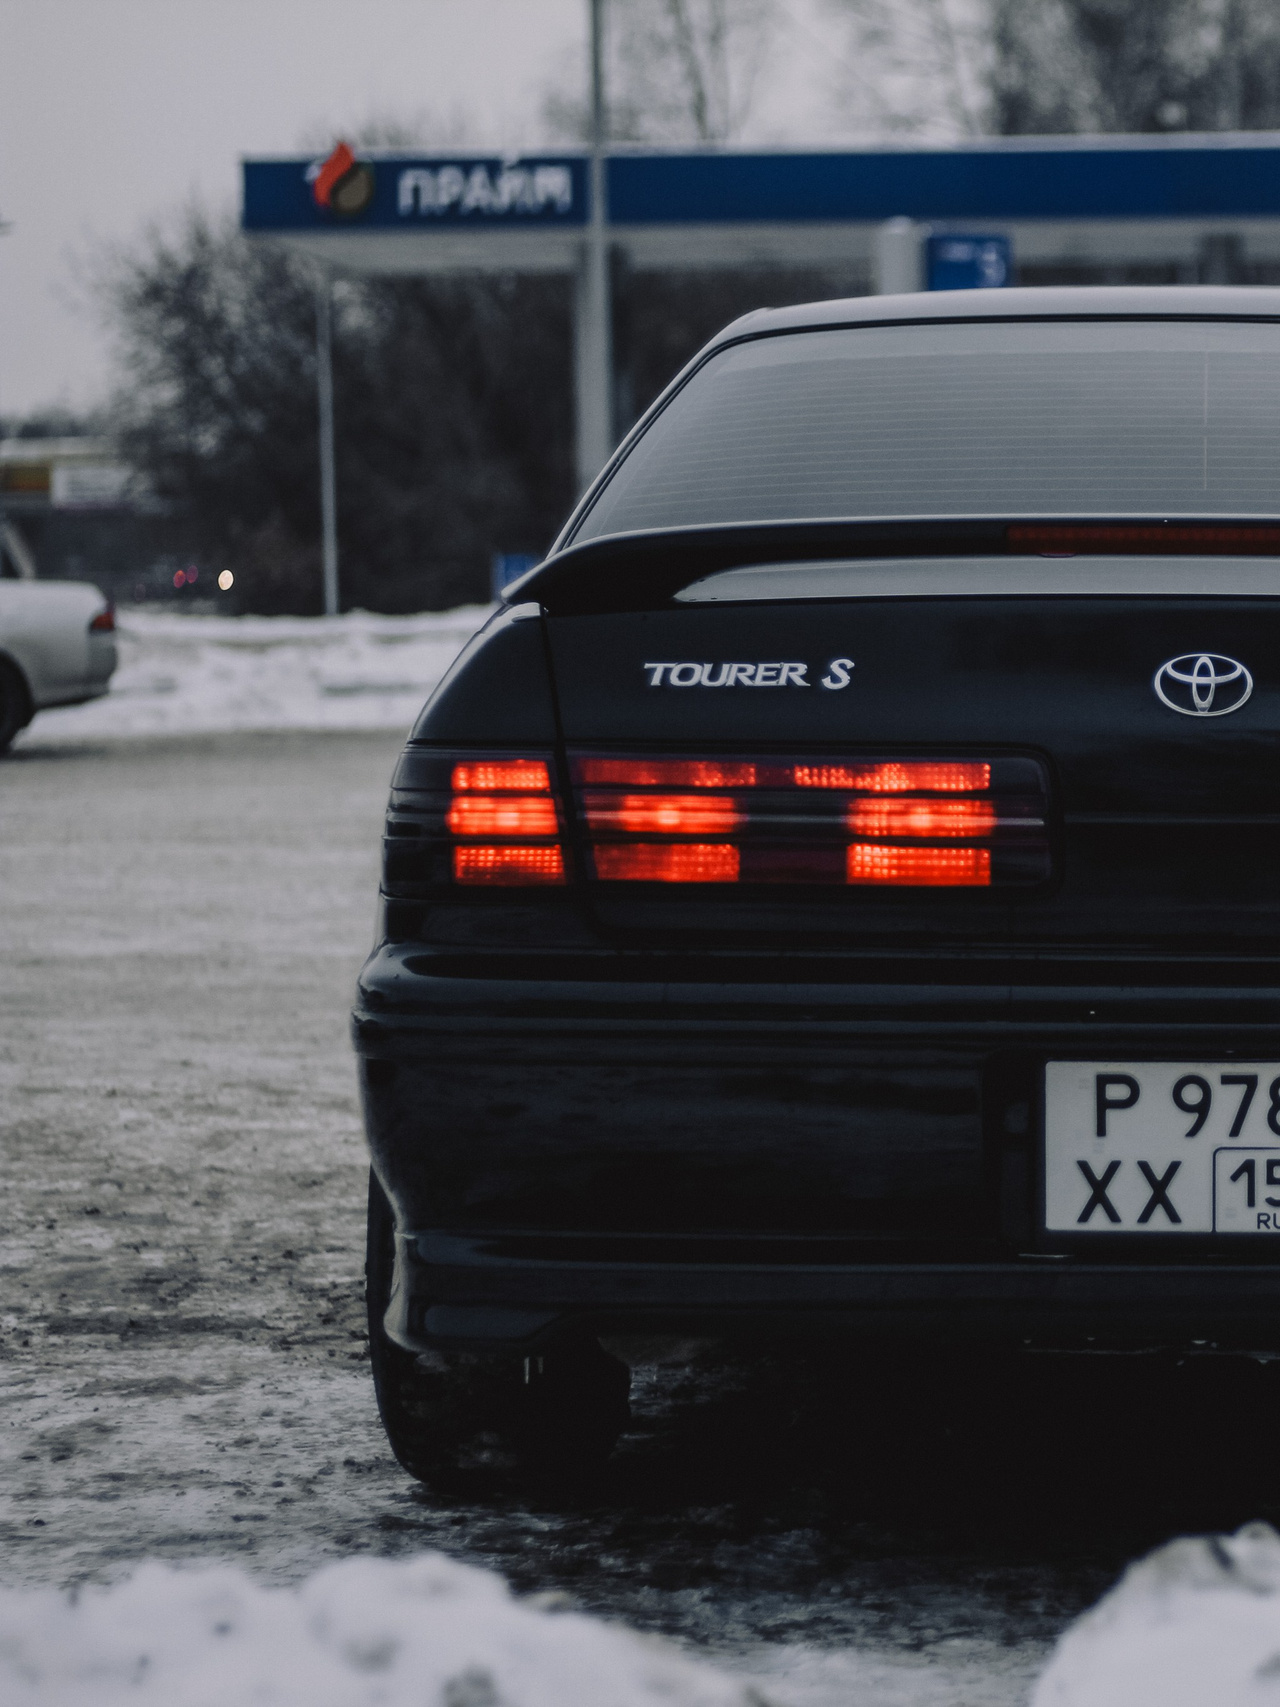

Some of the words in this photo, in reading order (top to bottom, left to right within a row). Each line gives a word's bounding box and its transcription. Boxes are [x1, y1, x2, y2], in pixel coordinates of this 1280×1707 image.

[398, 150, 571, 215] ПРАЙМ
[644, 661, 811, 687] TOURER
[822, 658, 855, 690] S
[1096, 1074, 1140, 1137] P
[1076, 1160, 1182, 1223] XX
